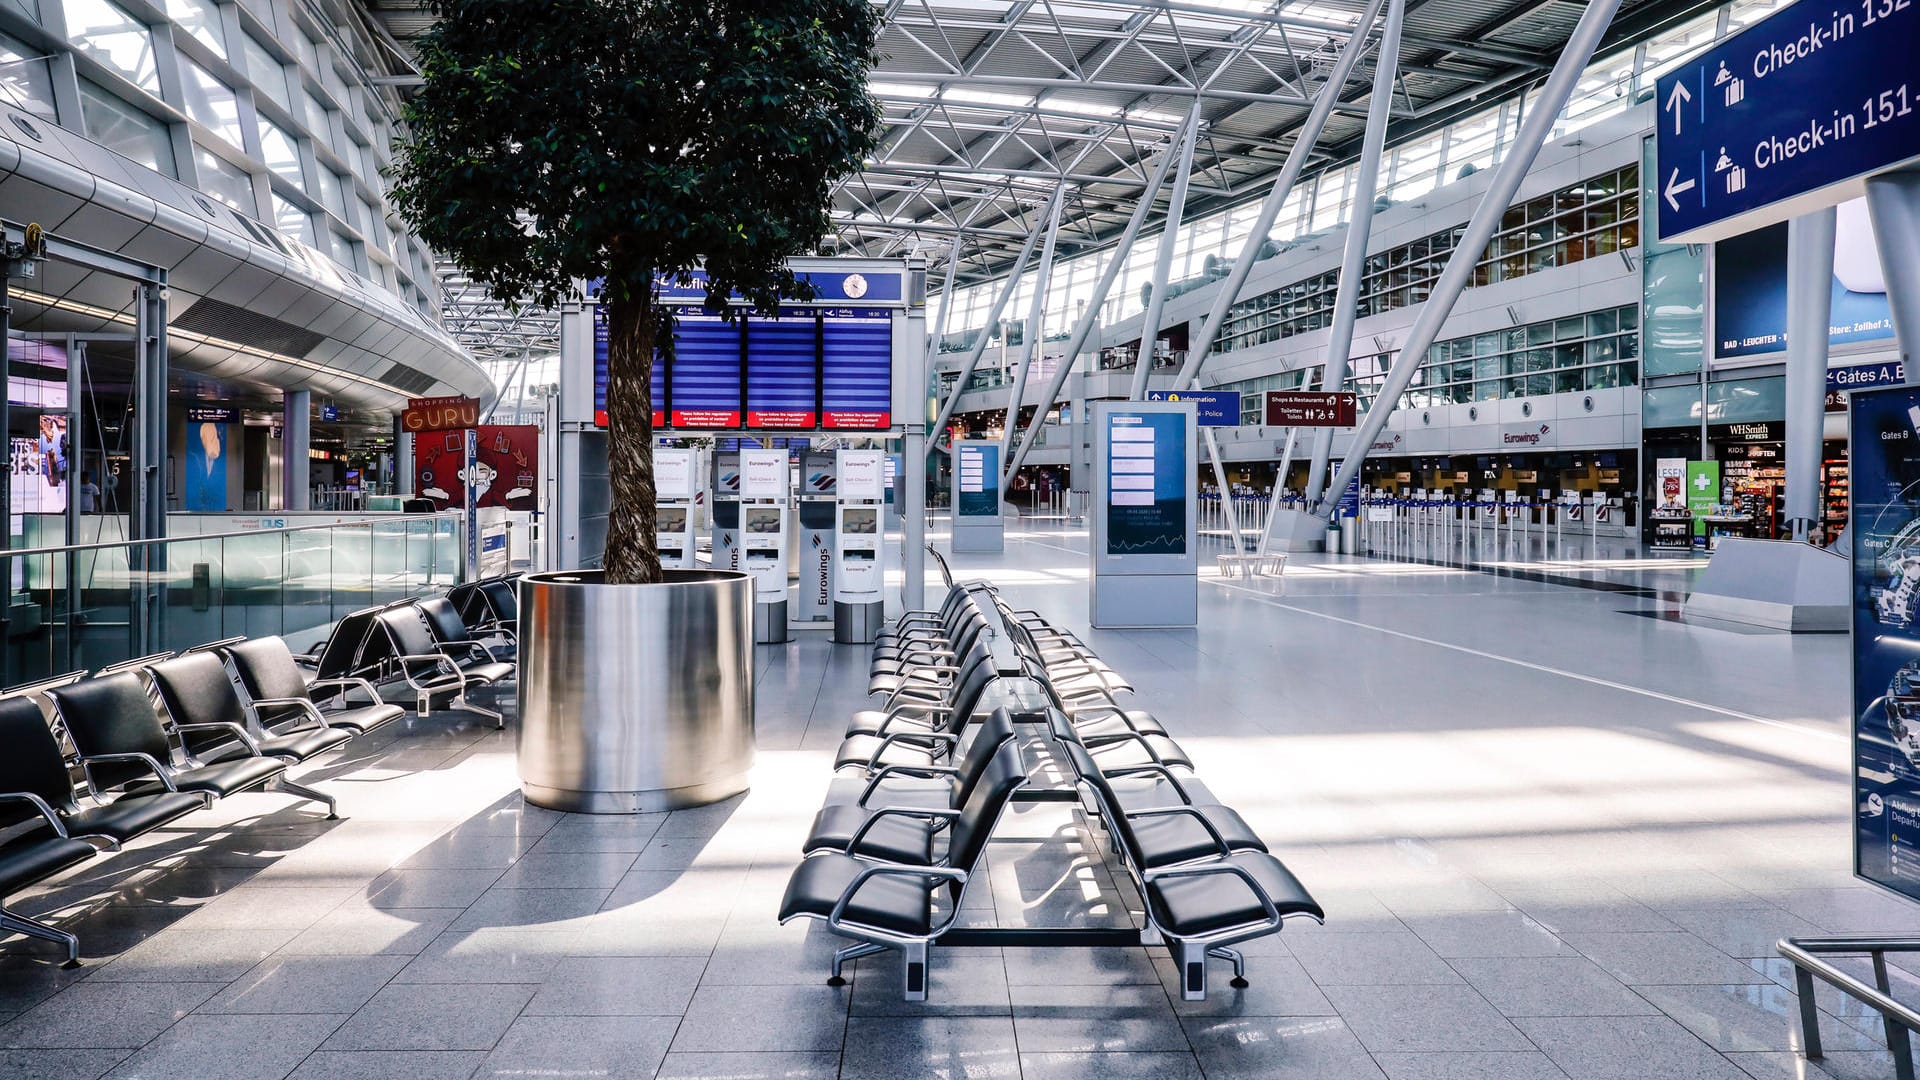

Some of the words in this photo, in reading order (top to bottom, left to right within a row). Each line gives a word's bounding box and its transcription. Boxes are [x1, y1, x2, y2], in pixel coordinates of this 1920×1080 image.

[1753, 10, 1854, 78] Check-in
[1754, 109, 1855, 169] Check-in
[1854, 320, 1882, 332] Zollhof
[1743, 334, 1777, 347] LEUCHTEN
[1836, 370, 1876, 384] Gates
[406, 407, 475, 429] GURU
[1504, 432, 1540, 444] Eurowings
[1881, 432, 1901, 440] Gates
[1658, 468, 1685, 478] LESEN
[1864, 538, 1883, 548] Gates
[1884, 540, 1890, 548] C
[818, 548, 830, 605] Eurowings
[1892, 800, 1915, 817] Abflug
